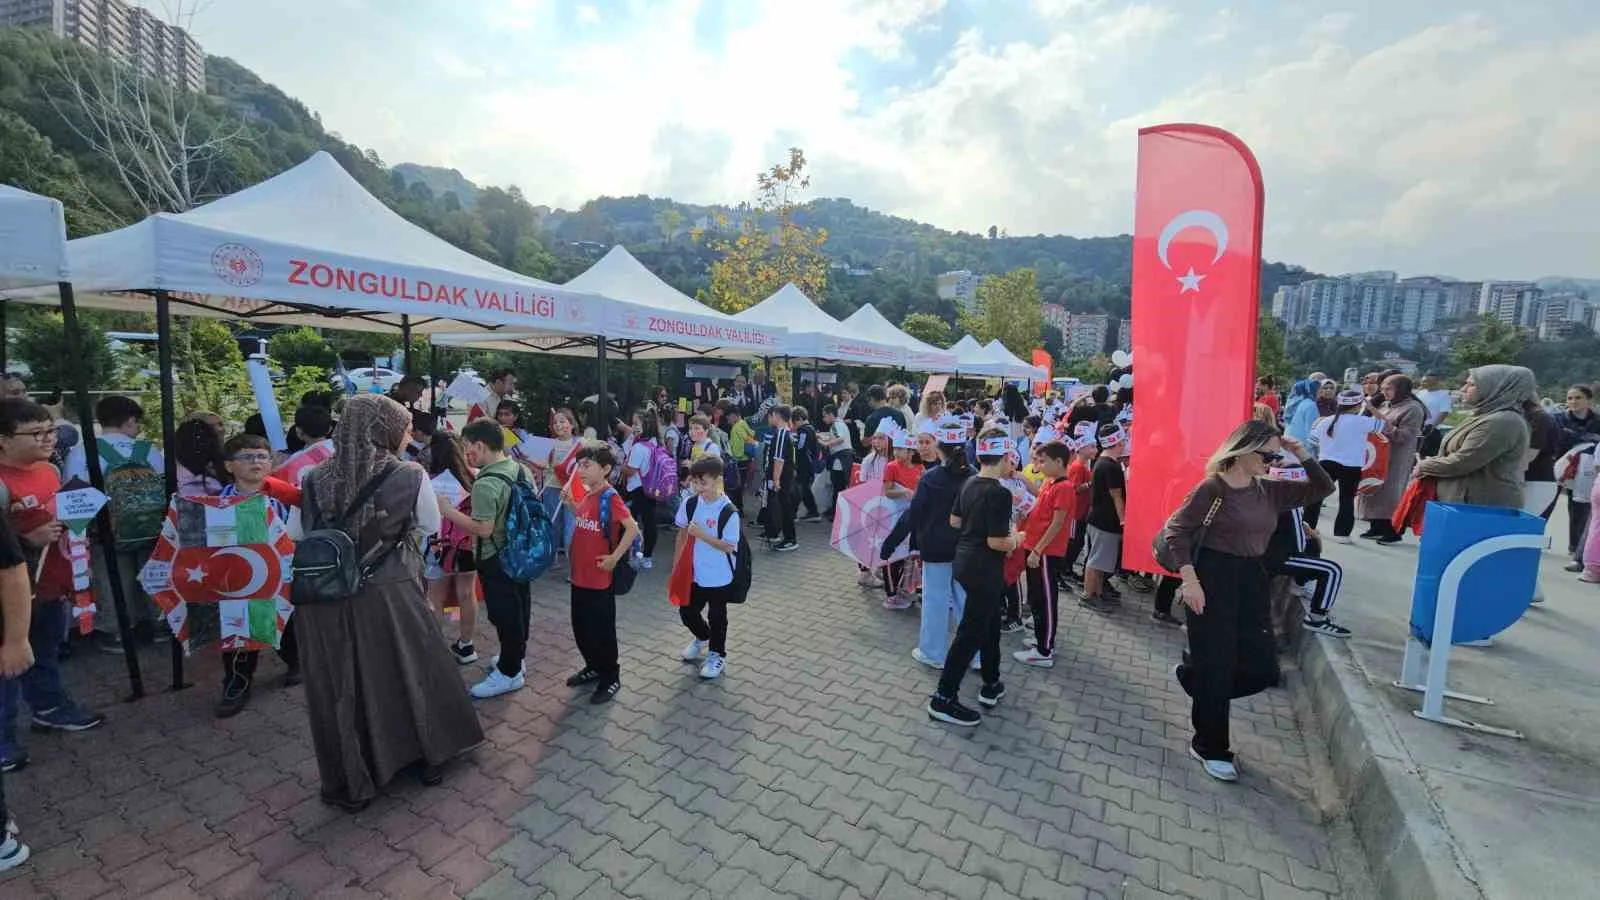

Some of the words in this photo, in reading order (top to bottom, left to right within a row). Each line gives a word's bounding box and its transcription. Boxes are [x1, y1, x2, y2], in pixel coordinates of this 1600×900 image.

[288, 259, 468, 306] ZONGULDAK
[474, 287, 556, 318] VALİLİĞİ
[648, 317, 722, 338] ZONGULDAK
